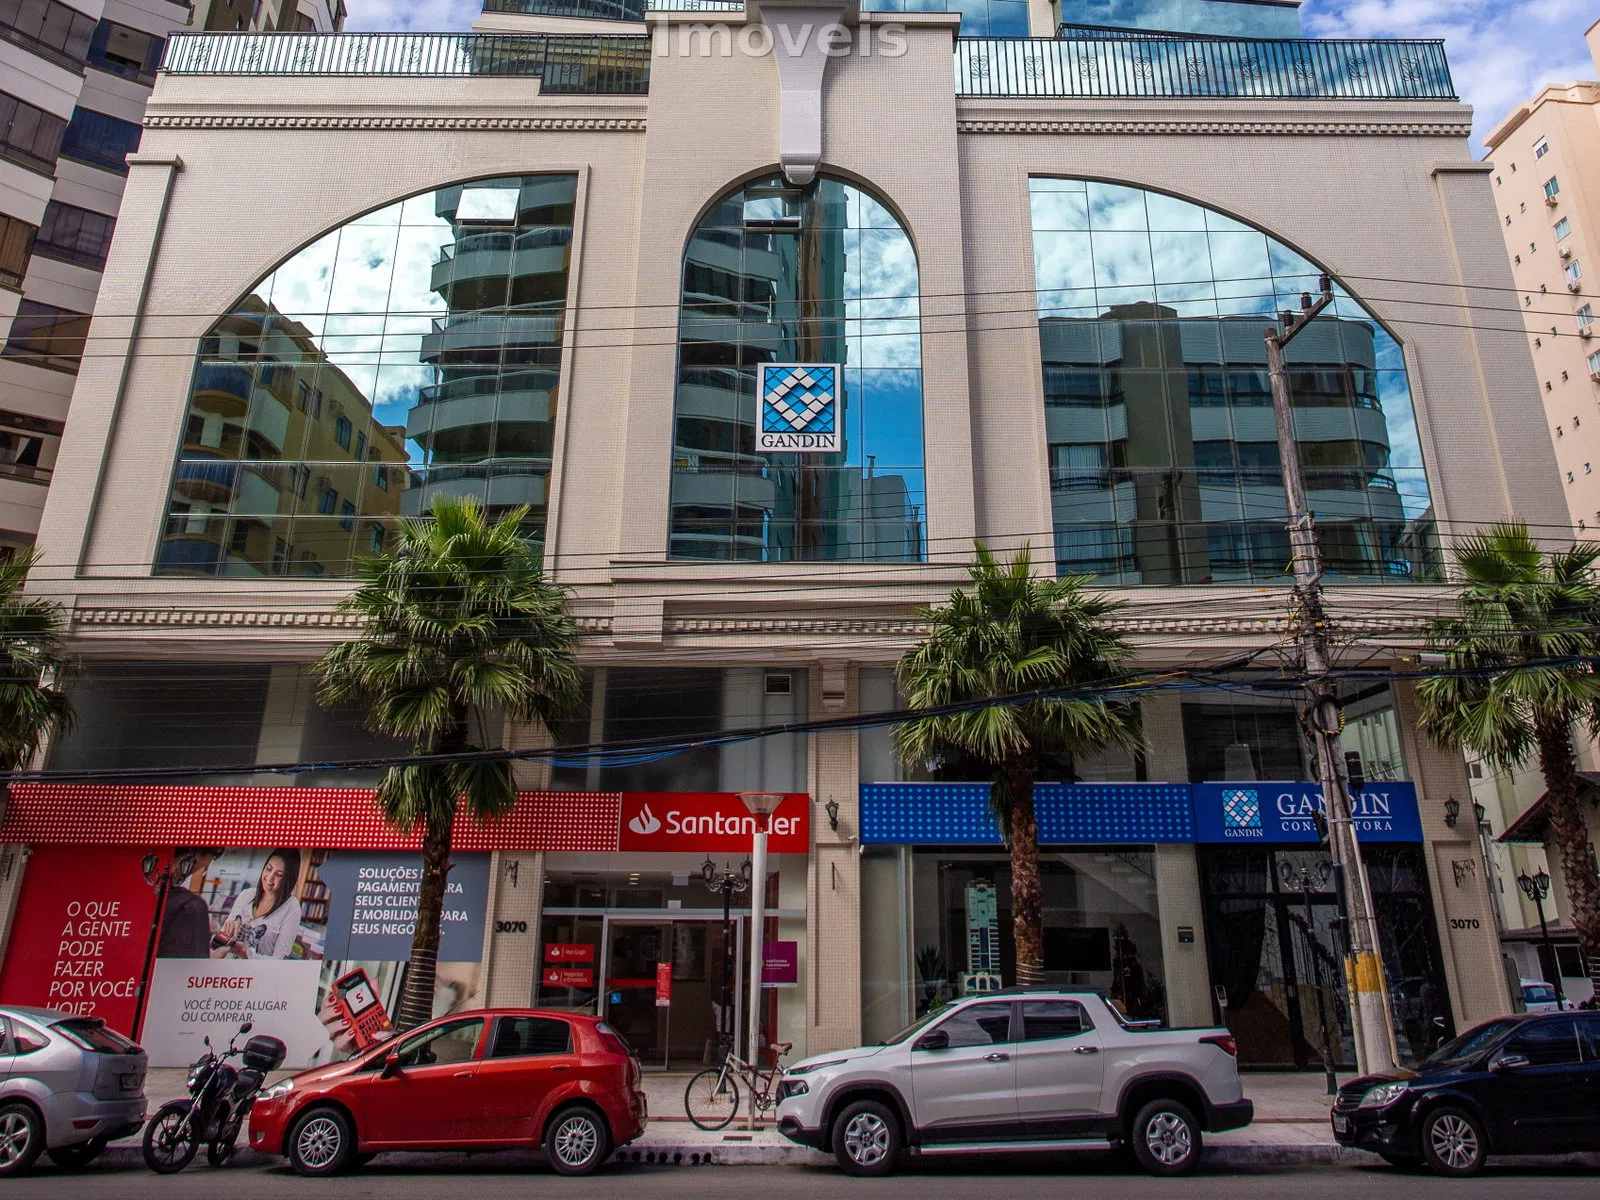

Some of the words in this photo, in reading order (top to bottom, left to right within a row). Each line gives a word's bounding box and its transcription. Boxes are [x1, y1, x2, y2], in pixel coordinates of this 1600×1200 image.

[761, 434, 837, 448] GANDIN
[1281, 821, 1393, 831] CONTORA
[1224, 829, 1264, 838] GANDIN
[358, 866, 418, 881] SOLUÇÕES
[356, 881, 422, 893] PAGAMENT
[444, 882, 464, 894] RA
[355, 895, 383, 906] SEUS
[385, 895, 422, 906] CLIEN
[67, 901, 81, 917] O
[85, 901, 120, 920] QUE
[353, 909, 361, 920] E
[362, 909, 419, 921] MOBILIDA
[61, 921, 74, 937] A
[78, 921, 132, 937] GENTE
[351, 923, 380, 934] SEUS
[495, 921, 527, 933] 3070
[1450, 918, 1480, 929] 3070
[58, 940, 105, 956] PODE
[53, 961, 104, 977] FAZER
[49, 981, 85, 997] POR
[89, 977, 135, 997] VOCÊ
[187, 976, 254, 989] SUPERGET
[183, 997, 212, 1010] VOCÊ
[214, 1000, 243, 1011] PODE
[244, 1000, 288, 1011] ALUGAR
[181, 1012, 198, 1022] OU
[200, 1012, 255, 1023] COMPRAR.
